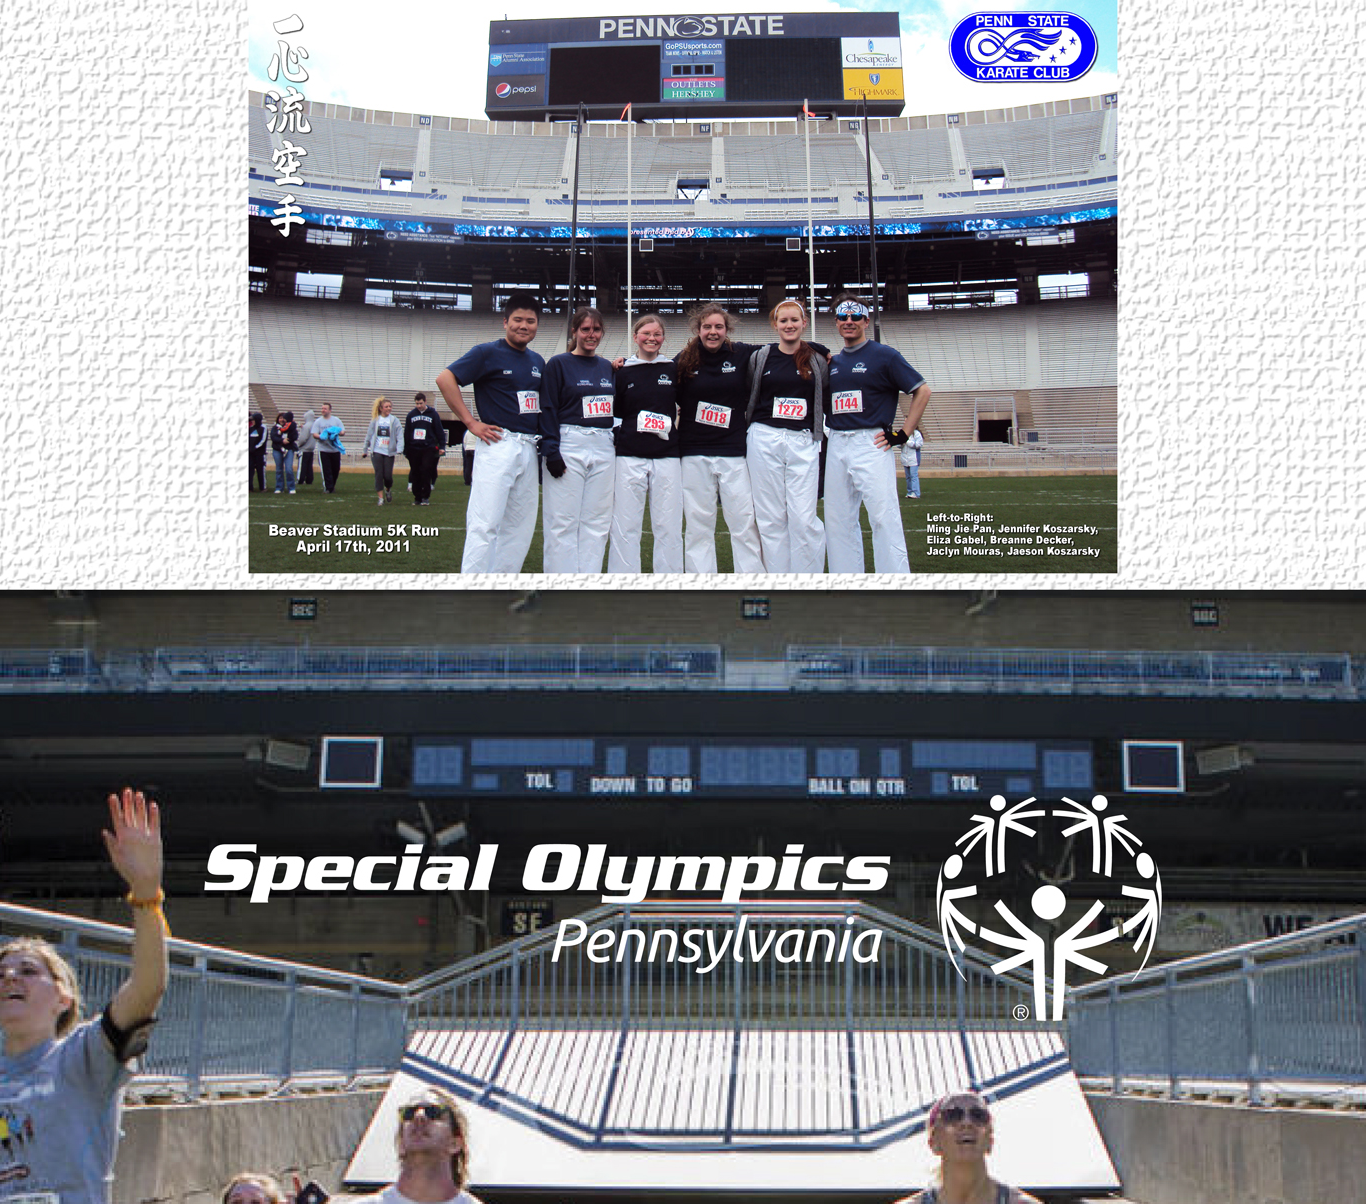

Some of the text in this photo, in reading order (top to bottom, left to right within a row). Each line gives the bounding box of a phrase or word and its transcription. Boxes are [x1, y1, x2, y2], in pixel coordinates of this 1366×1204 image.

[599, 15, 784, 39] PENN STATE
[665, 43, 722, 53] GoPSUsports.com
[845, 53, 898, 66] Chesapeake
[512, 85, 537, 95] pepsi
[671, 81, 716, 89] OUTLETS
[671, 90, 715, 98] HERSHEY
[586, 401, 612, 415] 1143
[700, 408, 727, 425] 1018
[526, 773, 552, 788] TOL
[591, 778, 692, 792] DOWN TO GO
[809, 778, 904, 795] BALL ON QTR
[952, 775, 979, 790] TOL
